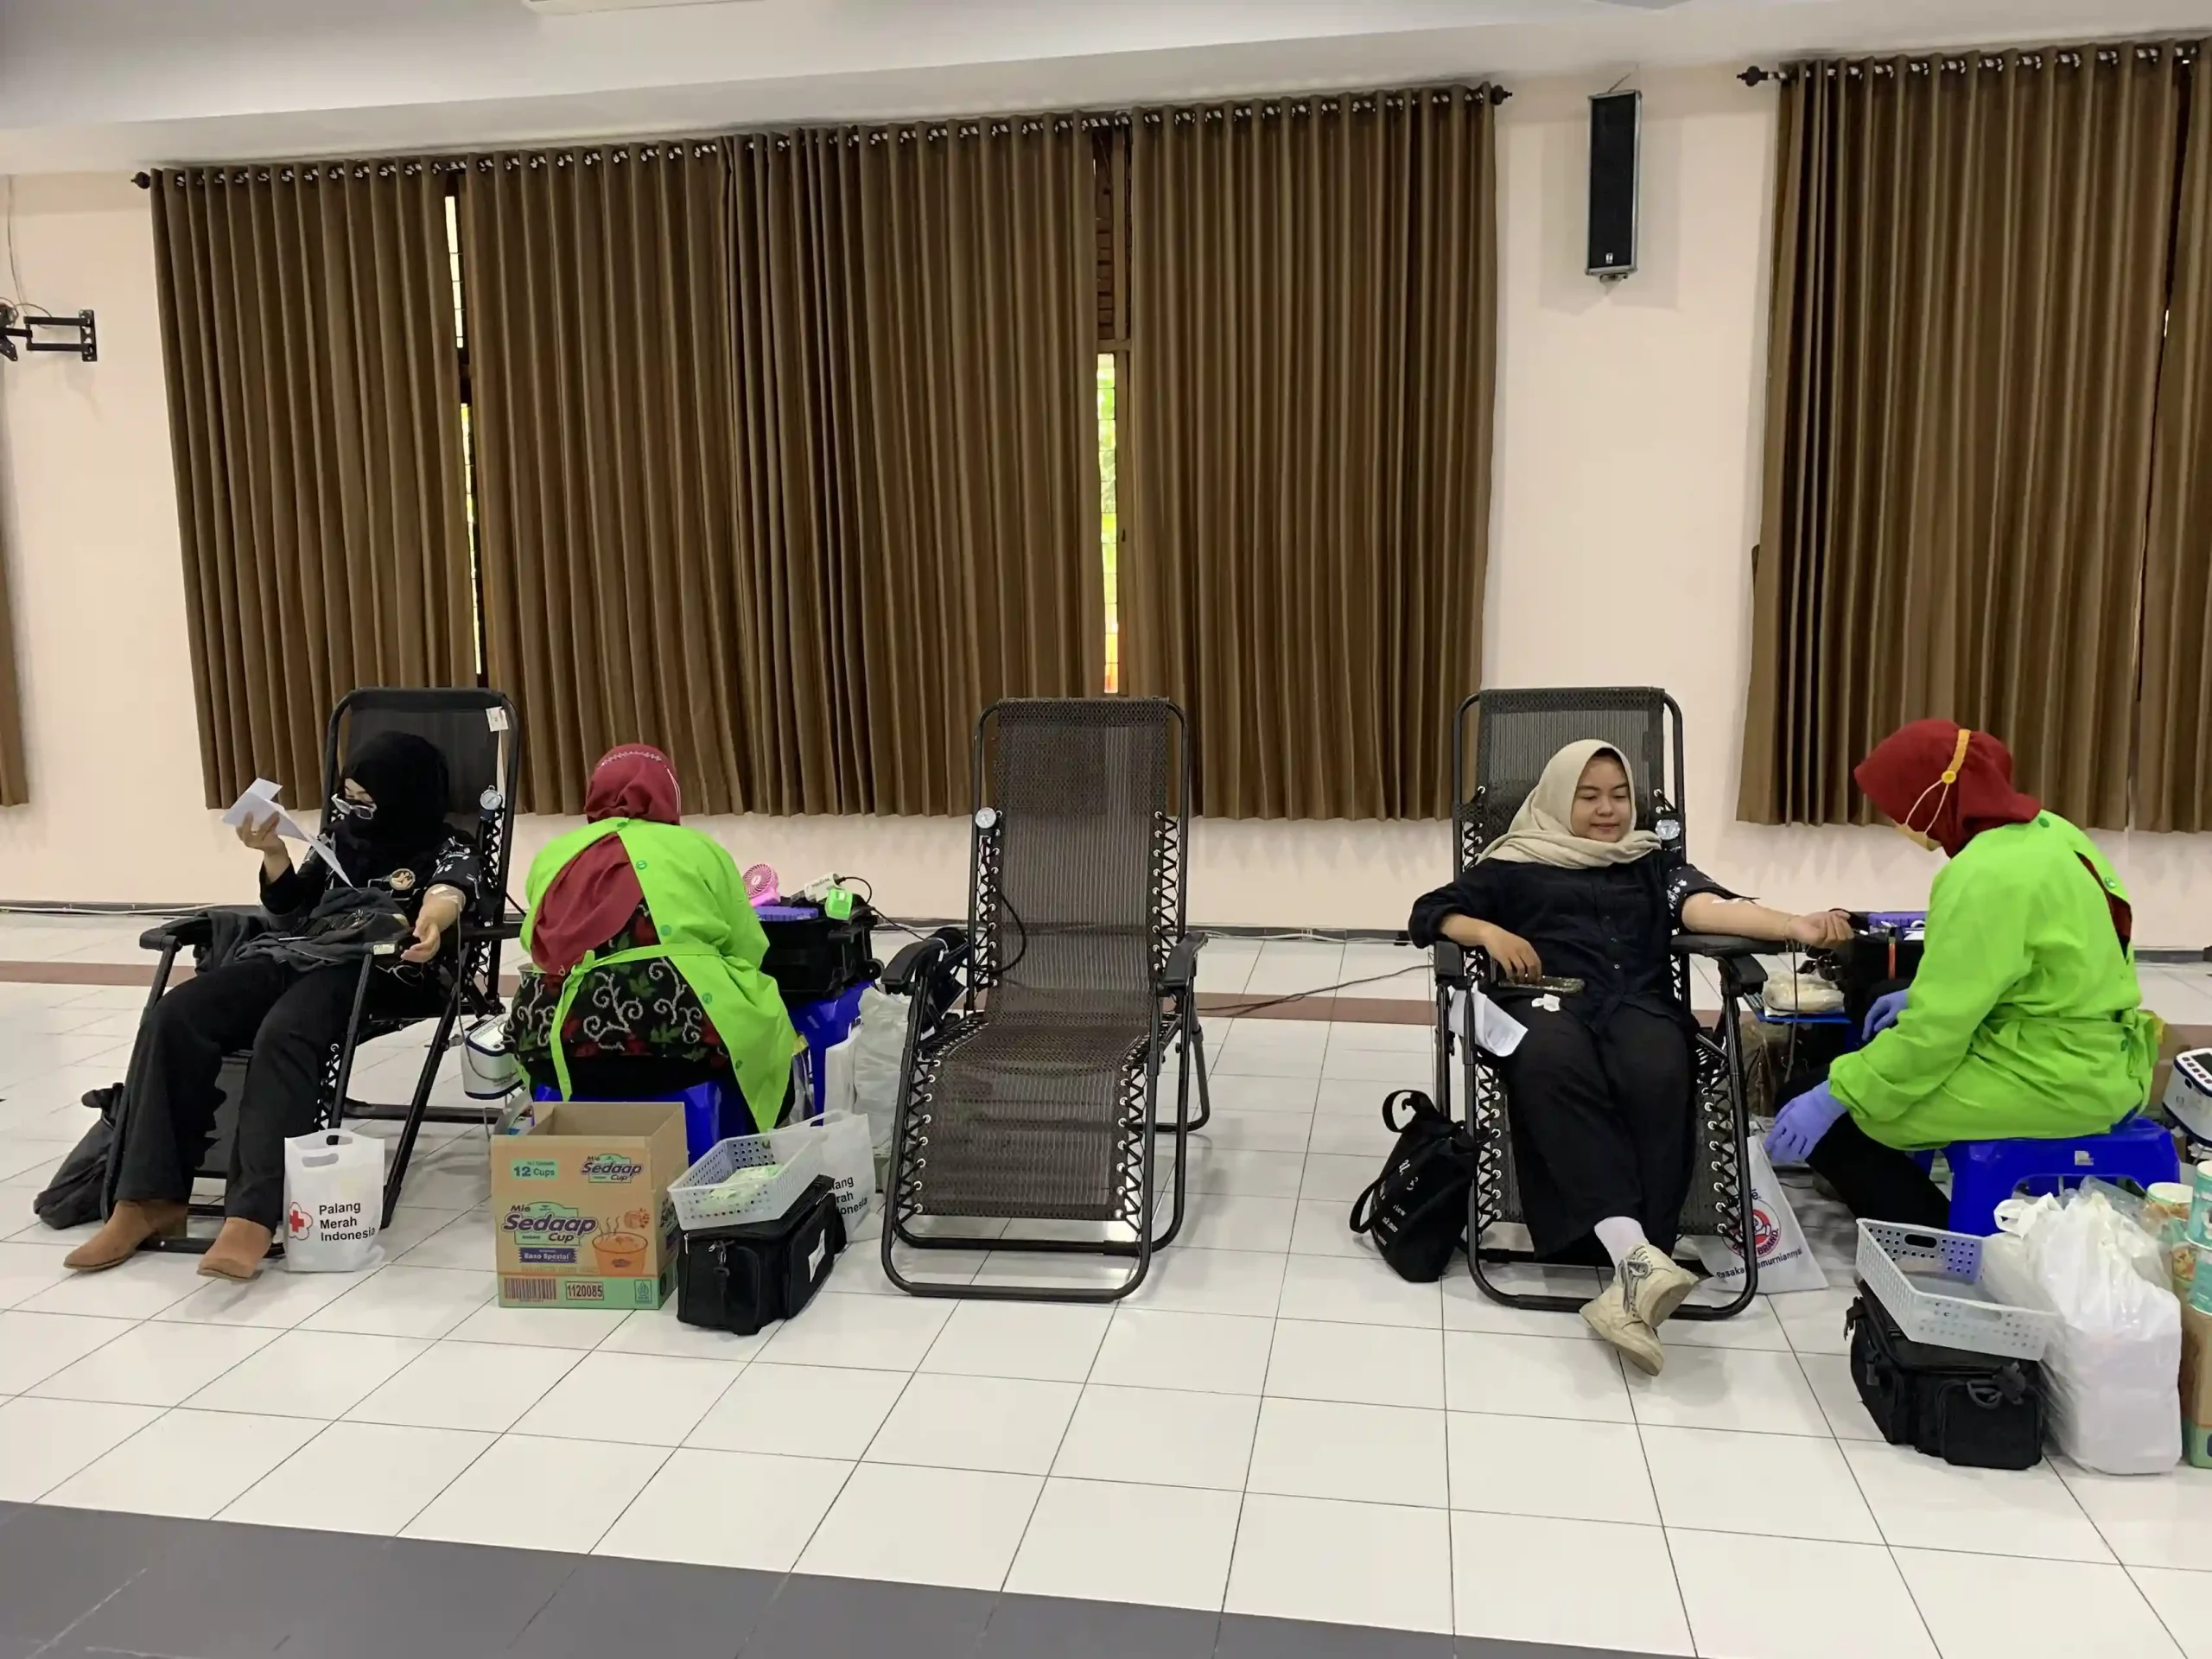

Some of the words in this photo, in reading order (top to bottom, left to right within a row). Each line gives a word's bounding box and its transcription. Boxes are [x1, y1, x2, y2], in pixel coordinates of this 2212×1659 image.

[513, 1166, 531, 1177] 12
[533, 1167, 555, 1178] Cups
[582, 1162, 642, 1176] Sedaap
[836, 1191, 854, 1203] rah
[319, 1202, 361, 1215] Palang
[838, 1197, 868, 1215] onesia
[320, 1217, 358, 1229] Merah
[503, 1213, 596, 1236] Sedaap
[321, 1226, 375, 1241] Indonesia
[548, 1232, 575, 1243] Cup
[567, 1284, 602, 1298] 1120085
